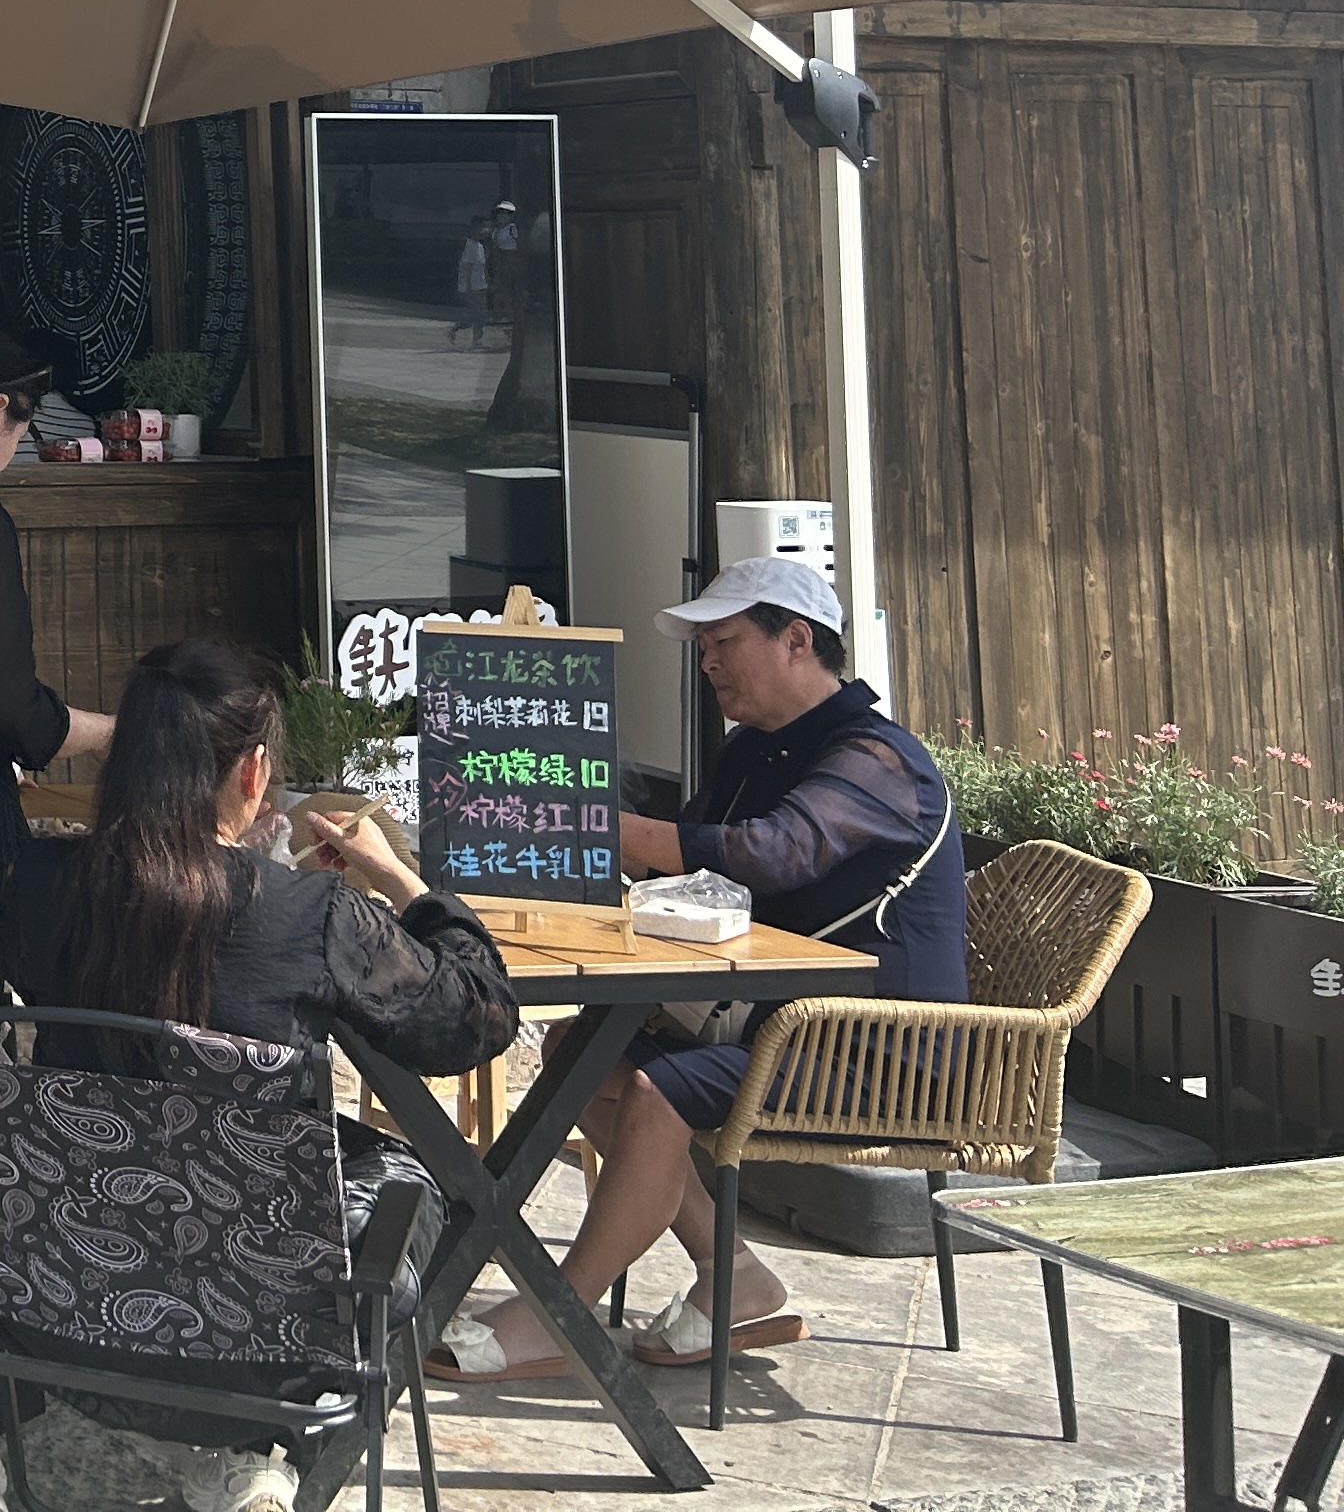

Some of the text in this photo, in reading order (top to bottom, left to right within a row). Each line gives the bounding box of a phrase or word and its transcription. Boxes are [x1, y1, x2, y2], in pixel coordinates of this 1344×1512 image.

[454, 694, 578, 729] 刺梨茉莉花
[458, 747, 609, 789] 柠檬绿 10
[459, 792, 609, 834] 柠檬红 10
[440, 840, 582, 880] 桂花牛乳
